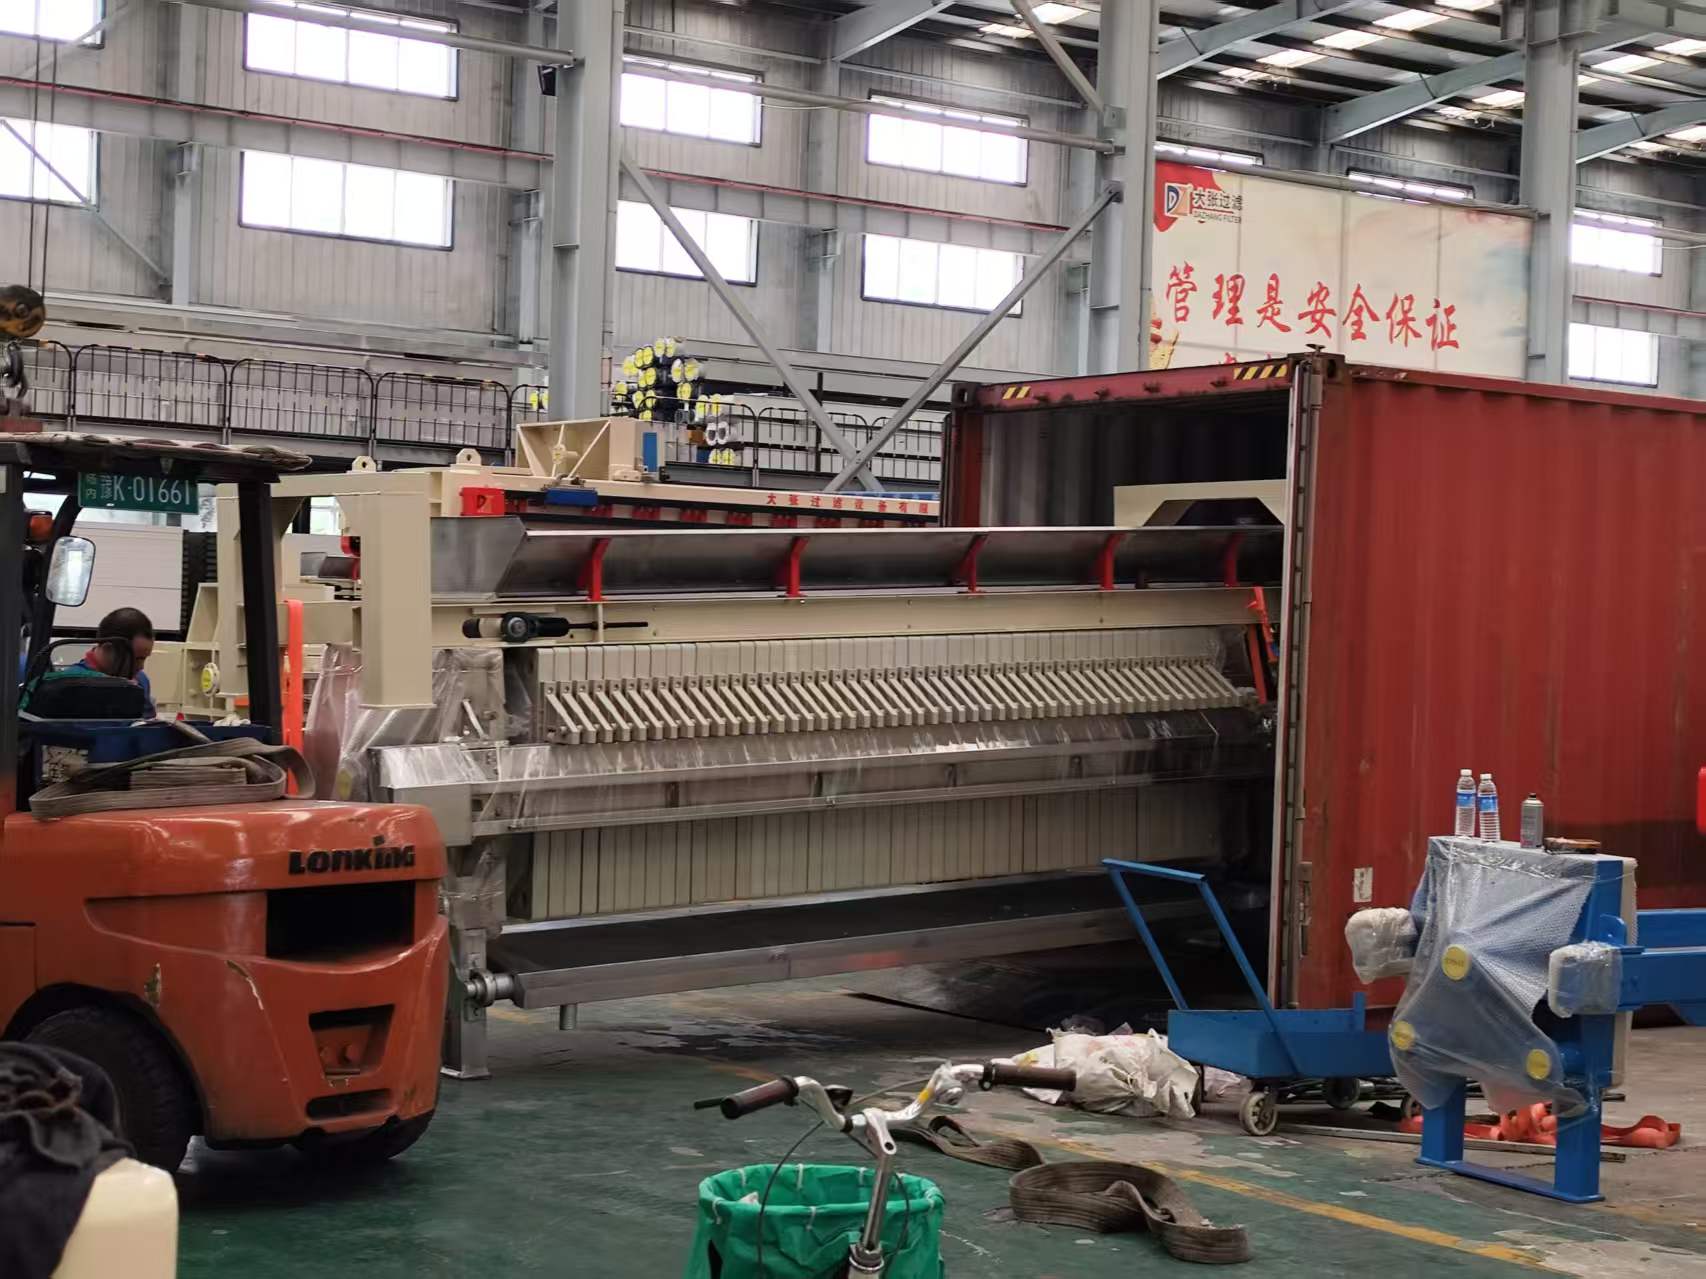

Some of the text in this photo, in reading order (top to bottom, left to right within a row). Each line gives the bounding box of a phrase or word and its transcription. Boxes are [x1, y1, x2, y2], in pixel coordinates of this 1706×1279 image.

[1193, 189, 1243, 211] 大张过滤
[1166, 261, 1459, 351] 管理是安全保证
